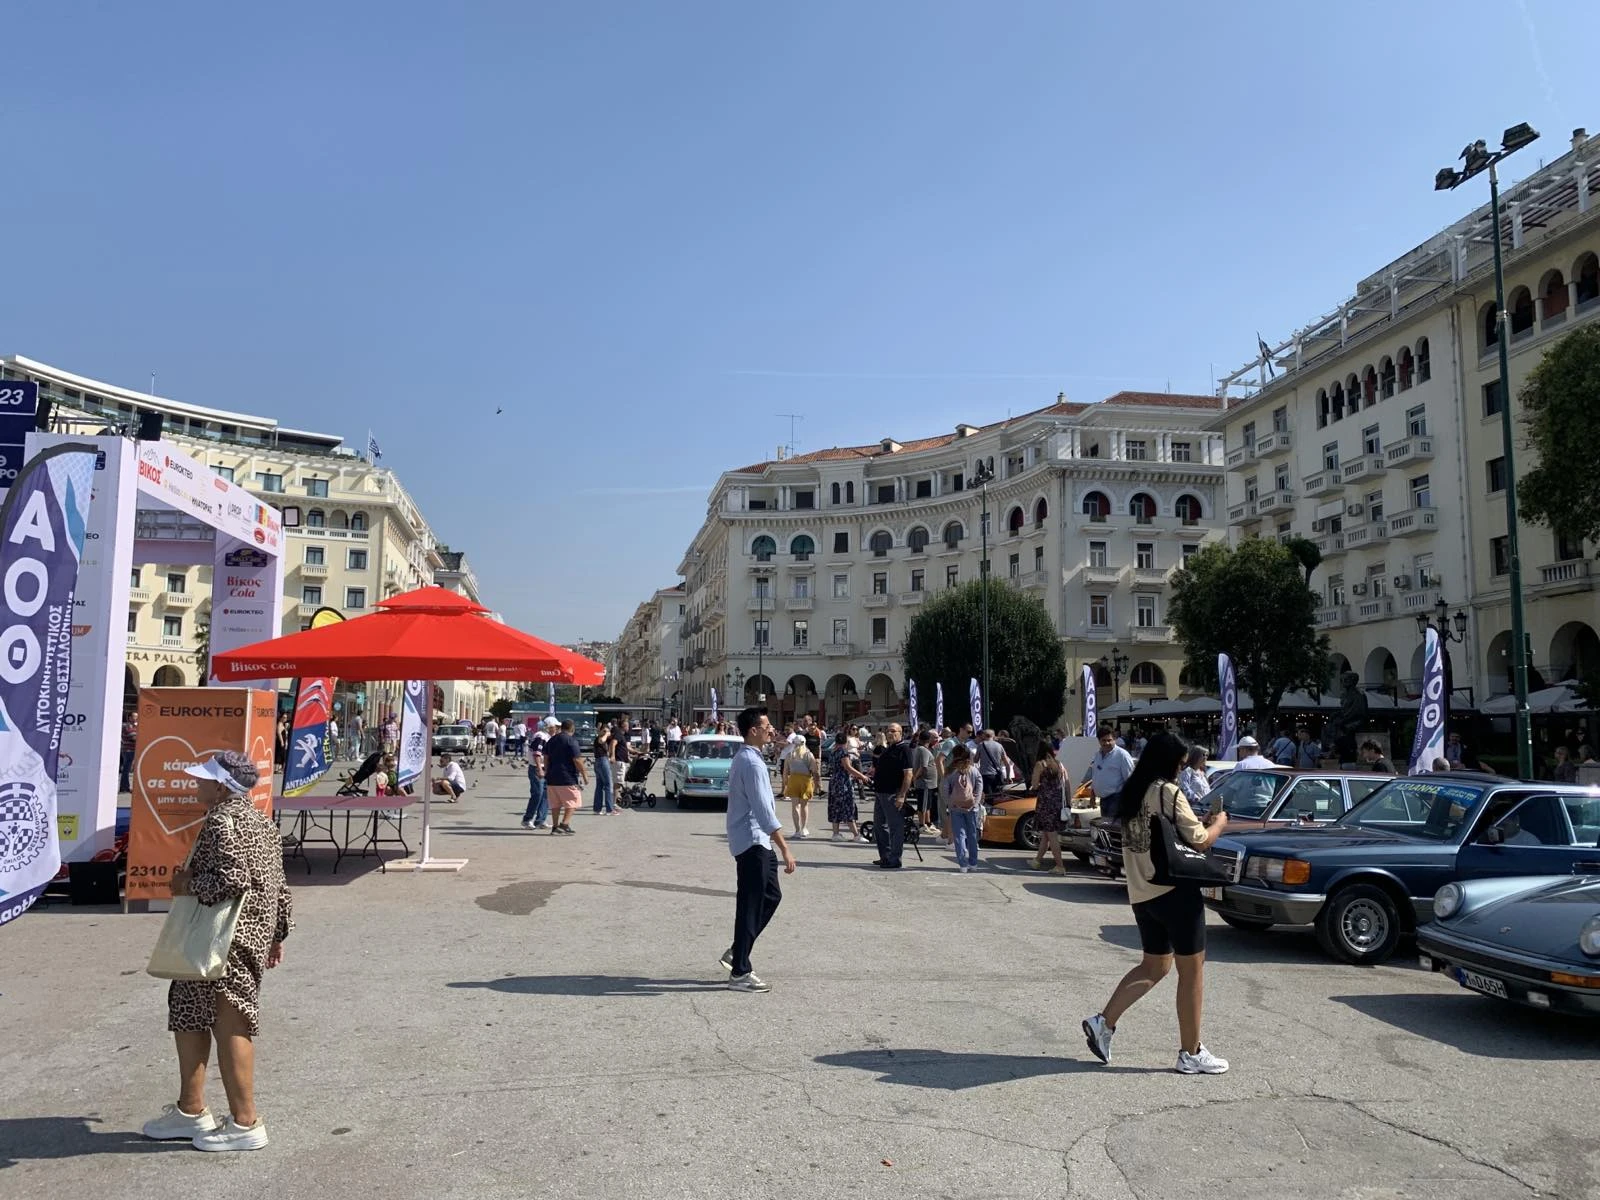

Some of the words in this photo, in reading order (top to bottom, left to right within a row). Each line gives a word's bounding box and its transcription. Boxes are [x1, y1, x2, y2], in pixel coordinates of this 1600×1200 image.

[230, 588, 256, 598] Cola
[270, 662, 297, 670] Cola
[160, 706, 244, 717] EUROKTEO
[130, 866, 168, 877] 2310
